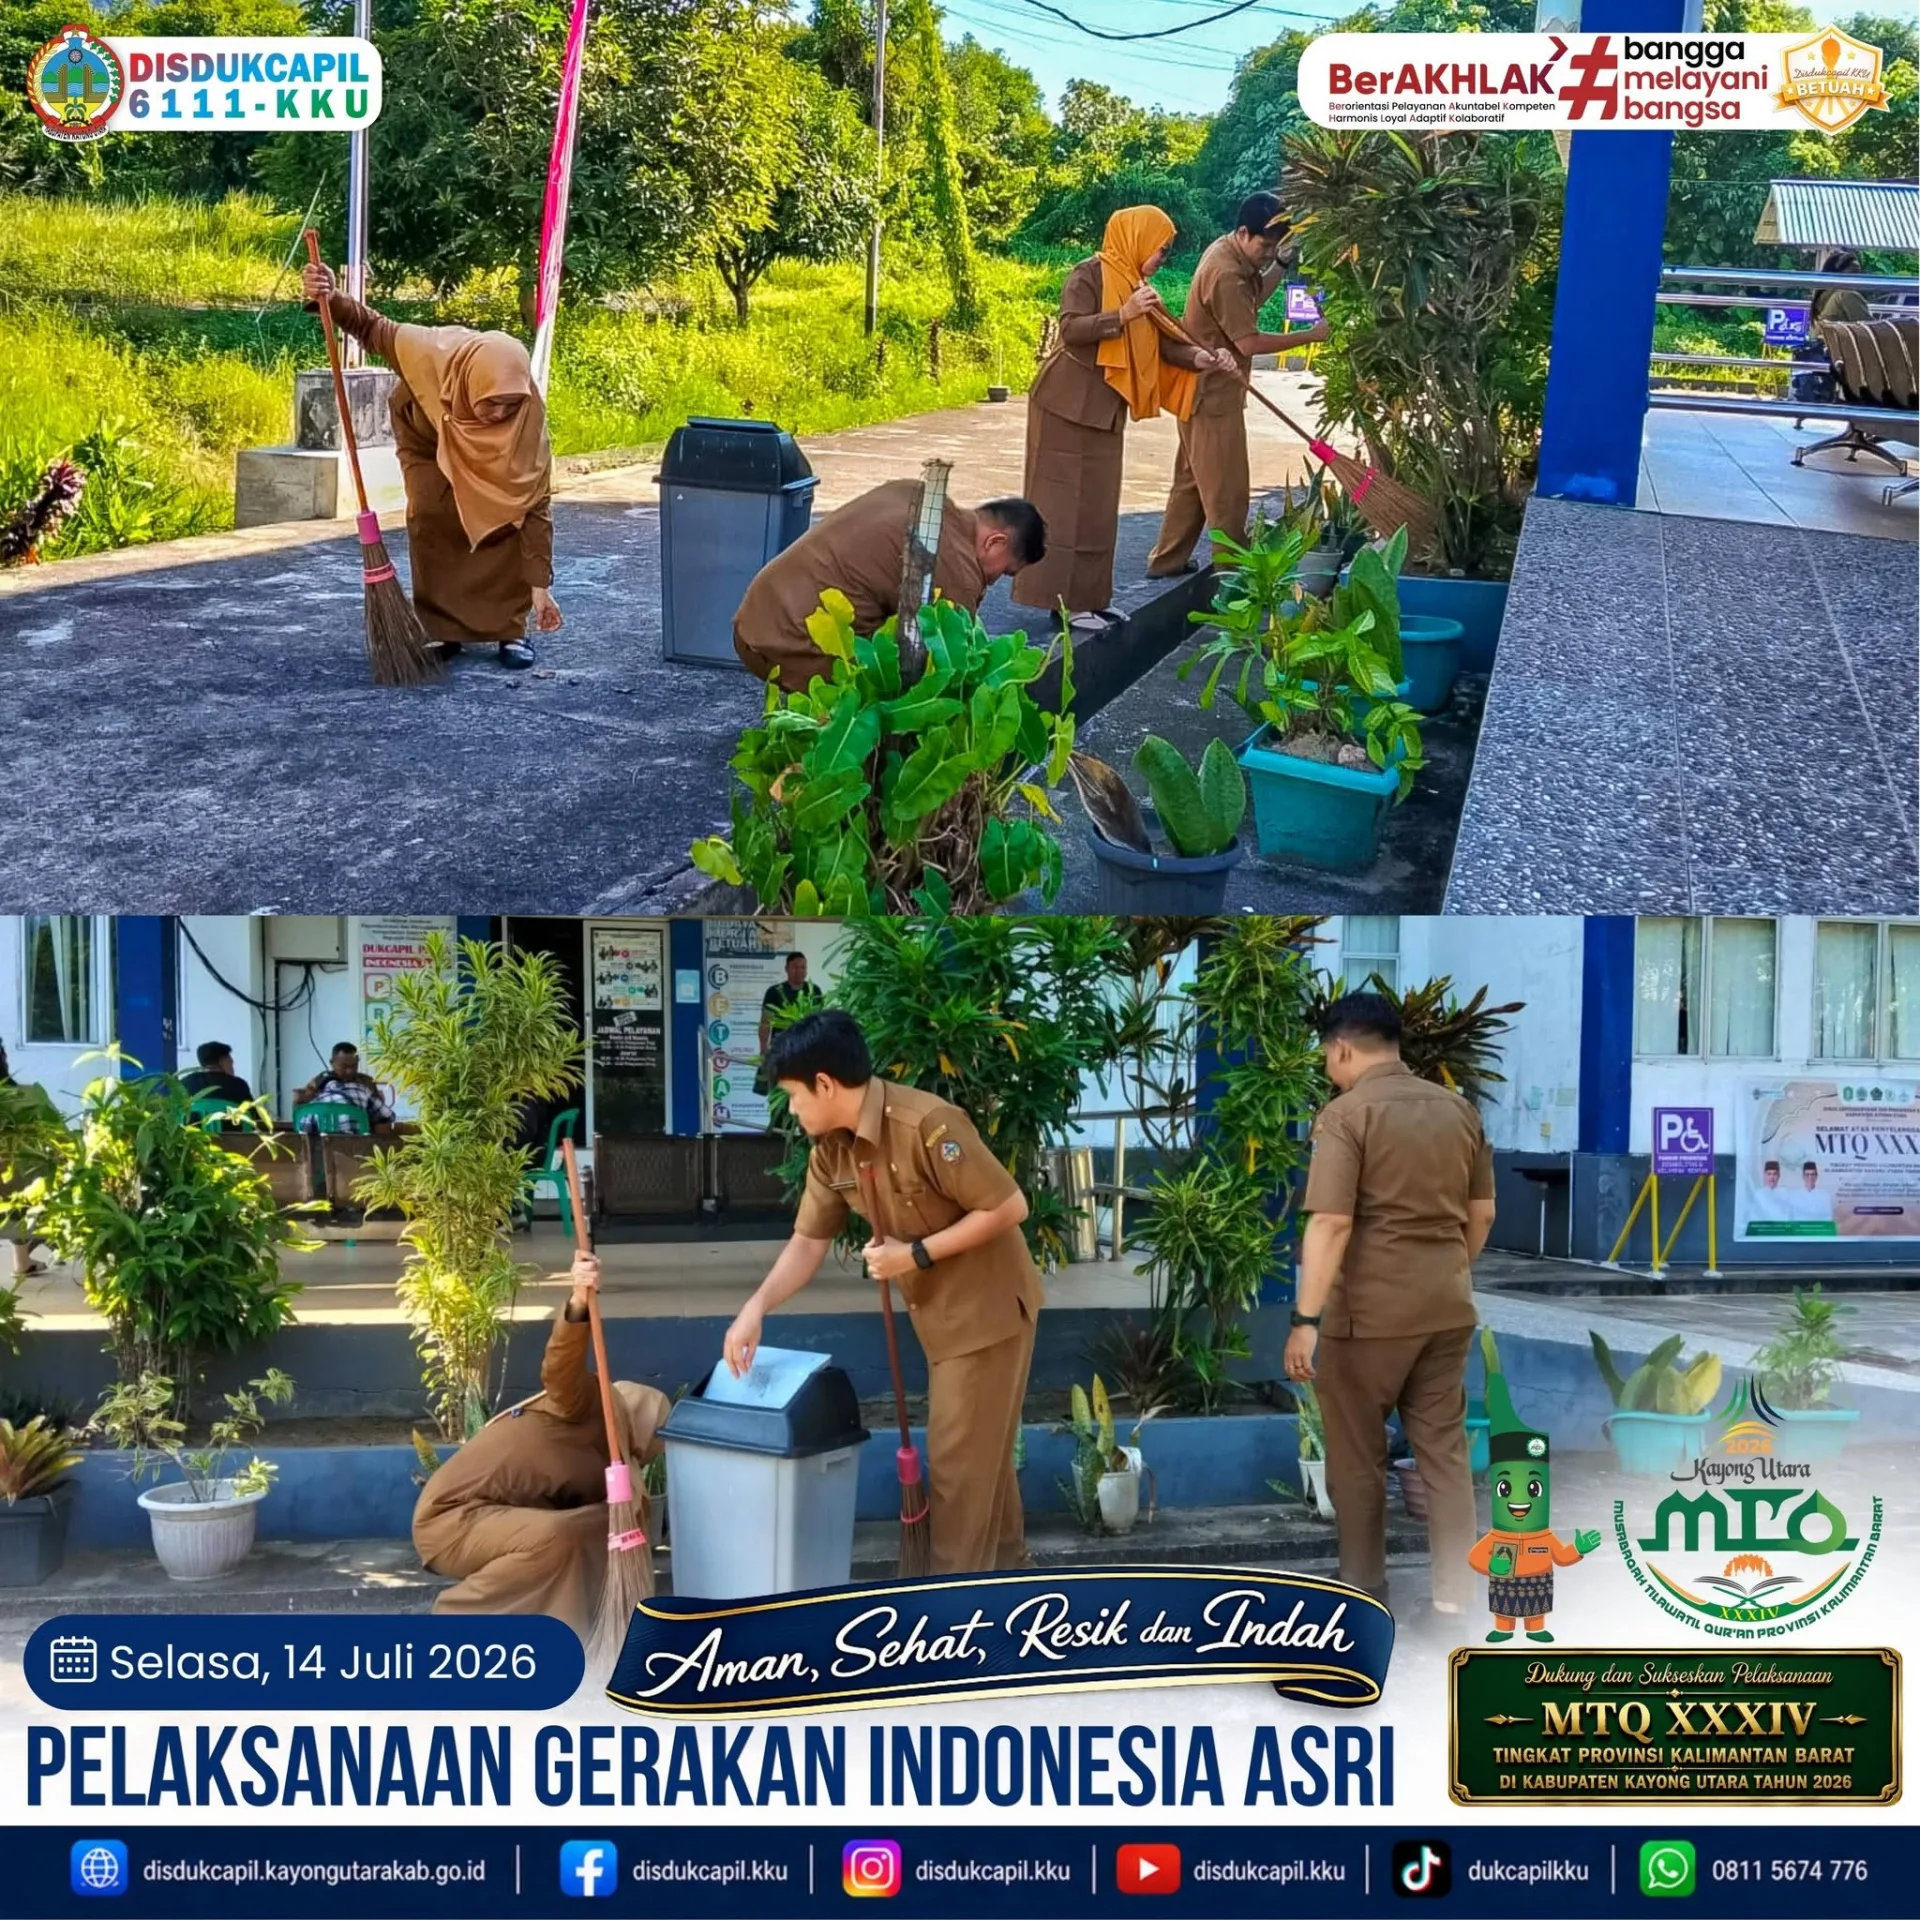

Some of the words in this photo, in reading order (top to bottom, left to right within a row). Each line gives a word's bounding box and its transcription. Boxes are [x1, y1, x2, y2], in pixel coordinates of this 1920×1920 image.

[1770, 309, 1786, 330] P
[1661, 1113, 1684, 1151] P
[1815, 1133, 1869, 1161] MTQ
